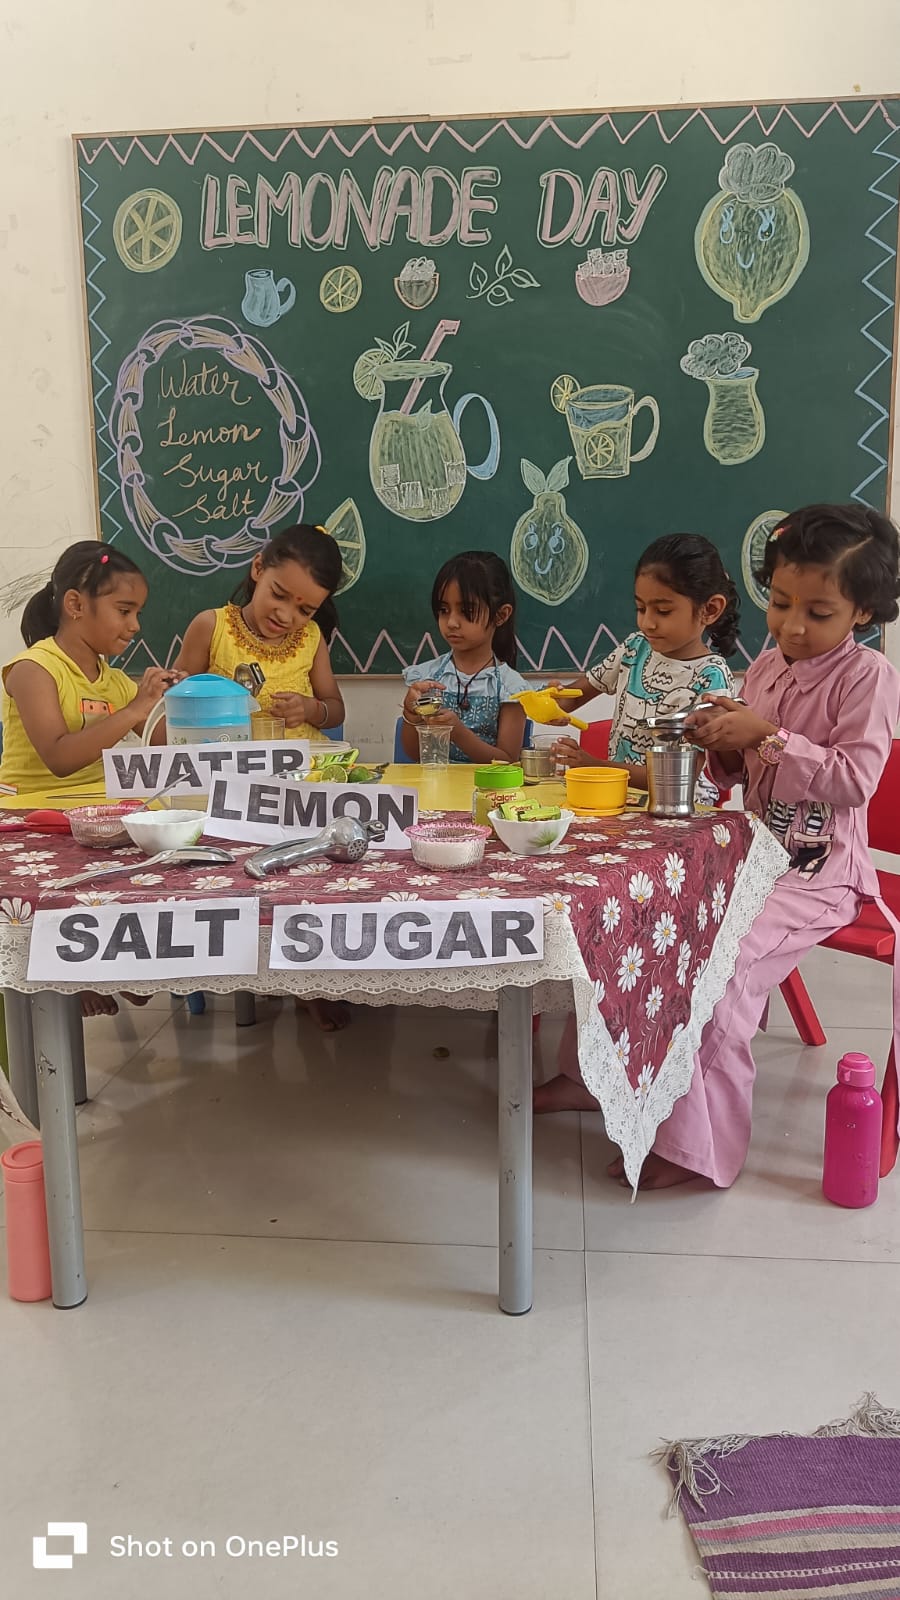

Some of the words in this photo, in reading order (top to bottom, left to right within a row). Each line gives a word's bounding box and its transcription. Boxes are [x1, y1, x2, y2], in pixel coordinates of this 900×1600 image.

[201, 165, 501, 251] LEMONADE
[537, 164, 668, 248] DAY
[160, 359, 252, 405] Water
[158, 407, 261, 447] Lemon
[163, 452, 268, 501] Sugar
[172, 488, 256, 523] Salt
[111, 749, 304, 790] WATER
[210, 780, 415, 831] LEMON
[56, 908, 240, 962] SALT
[281, 909, 538, 962] SUGAR
